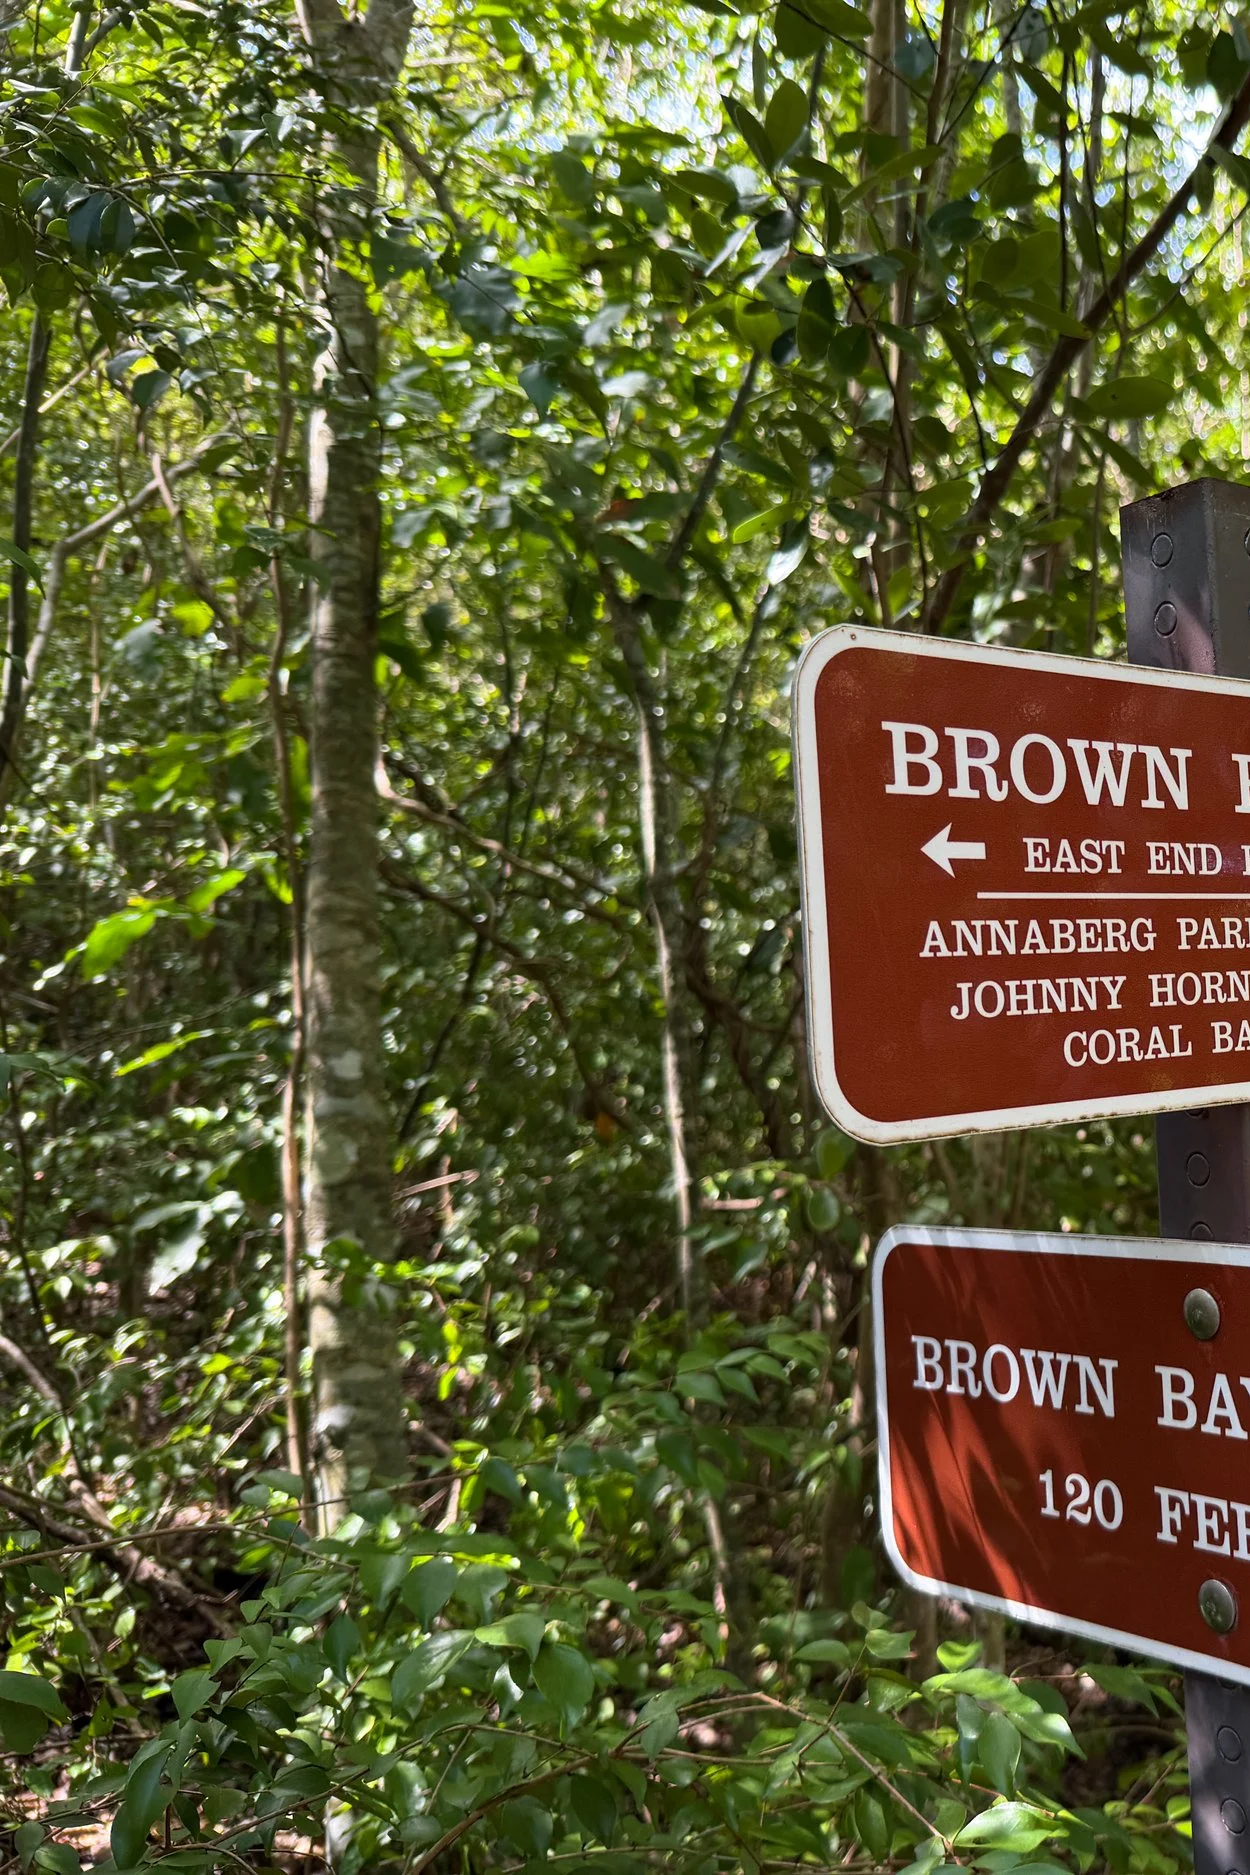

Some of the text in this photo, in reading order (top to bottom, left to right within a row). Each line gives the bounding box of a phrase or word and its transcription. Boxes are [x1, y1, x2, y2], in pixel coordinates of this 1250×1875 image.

[881, 721, 1192, 810] BROWN
[1023, 838, 1125, 874] EAST
[1146, 842, 1222, 875] END
[919, 918, 1156, 957] ANNABERG
[951, 976, 1126, 1020] JOHNNY
[1148, 971, 1250, 1007] HORN
[1064, 1025, 1192, 1067] CORAL
[911, 1335, 1118, 1417] BROWN
[1039, 1469, 1123, 1530] 120
